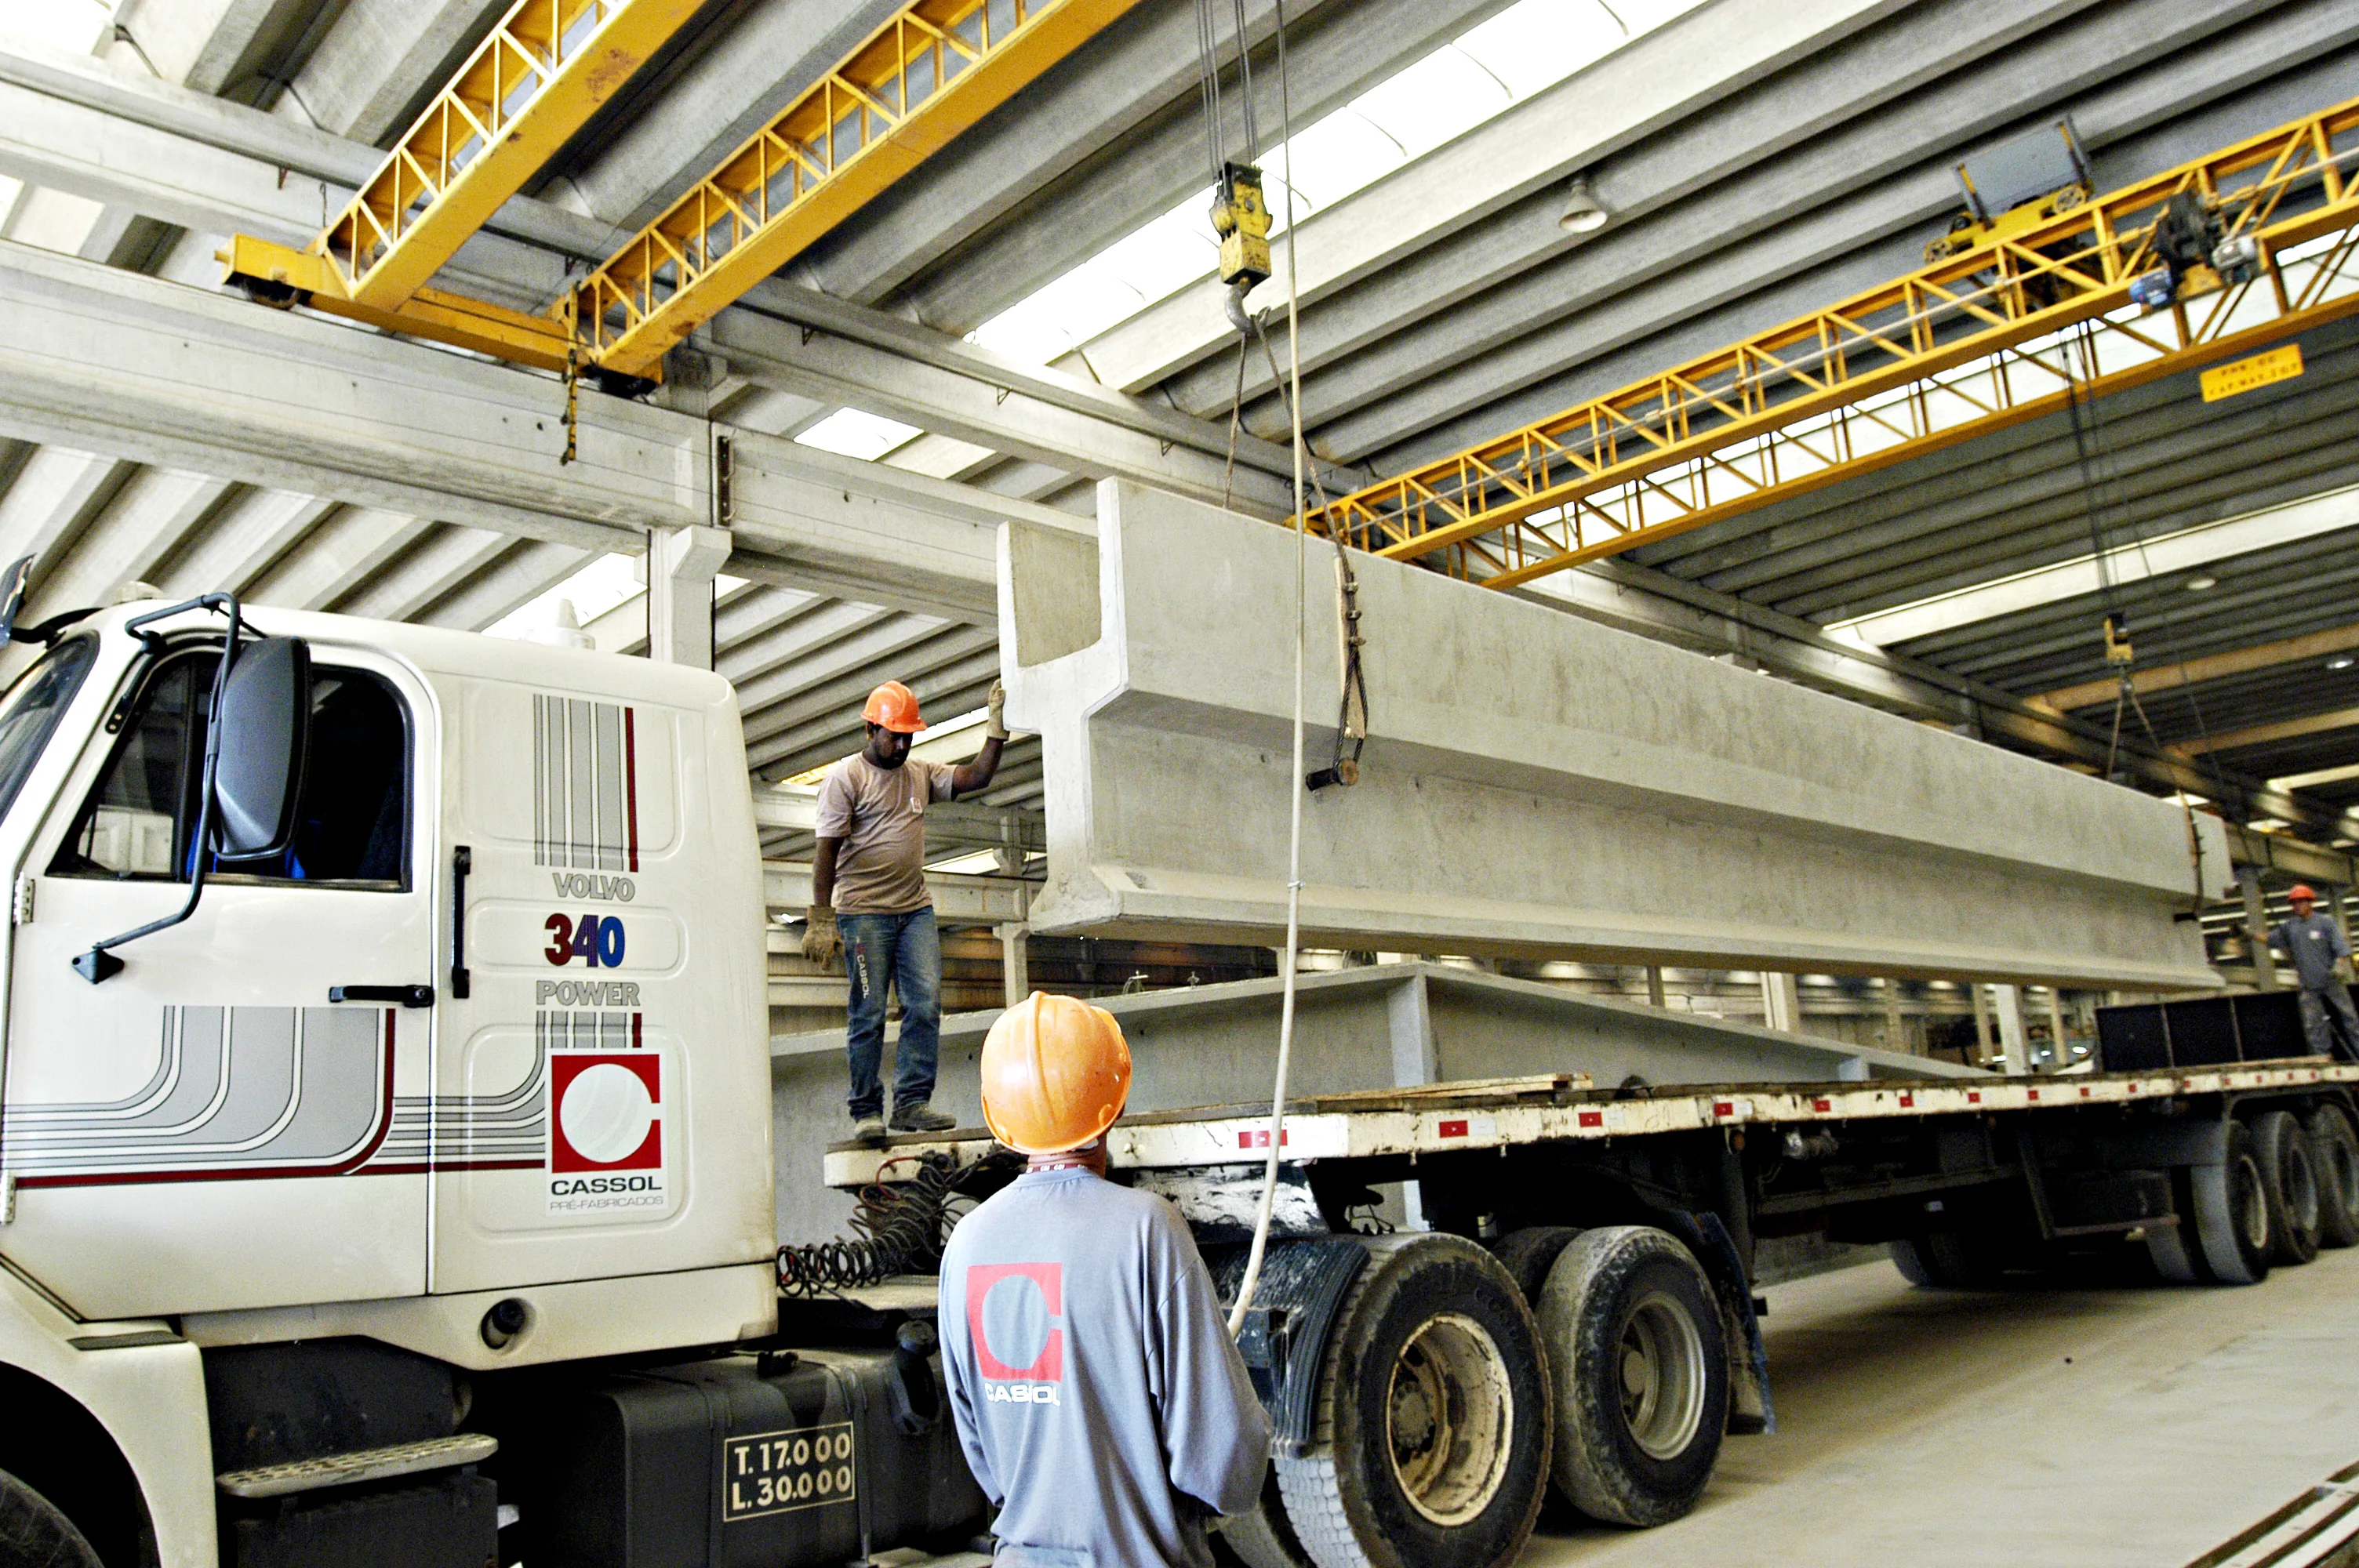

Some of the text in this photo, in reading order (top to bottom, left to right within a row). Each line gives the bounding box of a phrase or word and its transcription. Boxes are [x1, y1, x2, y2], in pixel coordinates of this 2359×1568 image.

[552, 873, 635, 902] VOLVO
[544, 913, 625, 967] 340
[536, 980, 640, 1007] POWER
[551, 1175, 662, 1196] CASSOL
[550, 1196, 663, 1210] PRÉ-FABRICADOS
[984, 1382, 1061, 1406] CASOL
